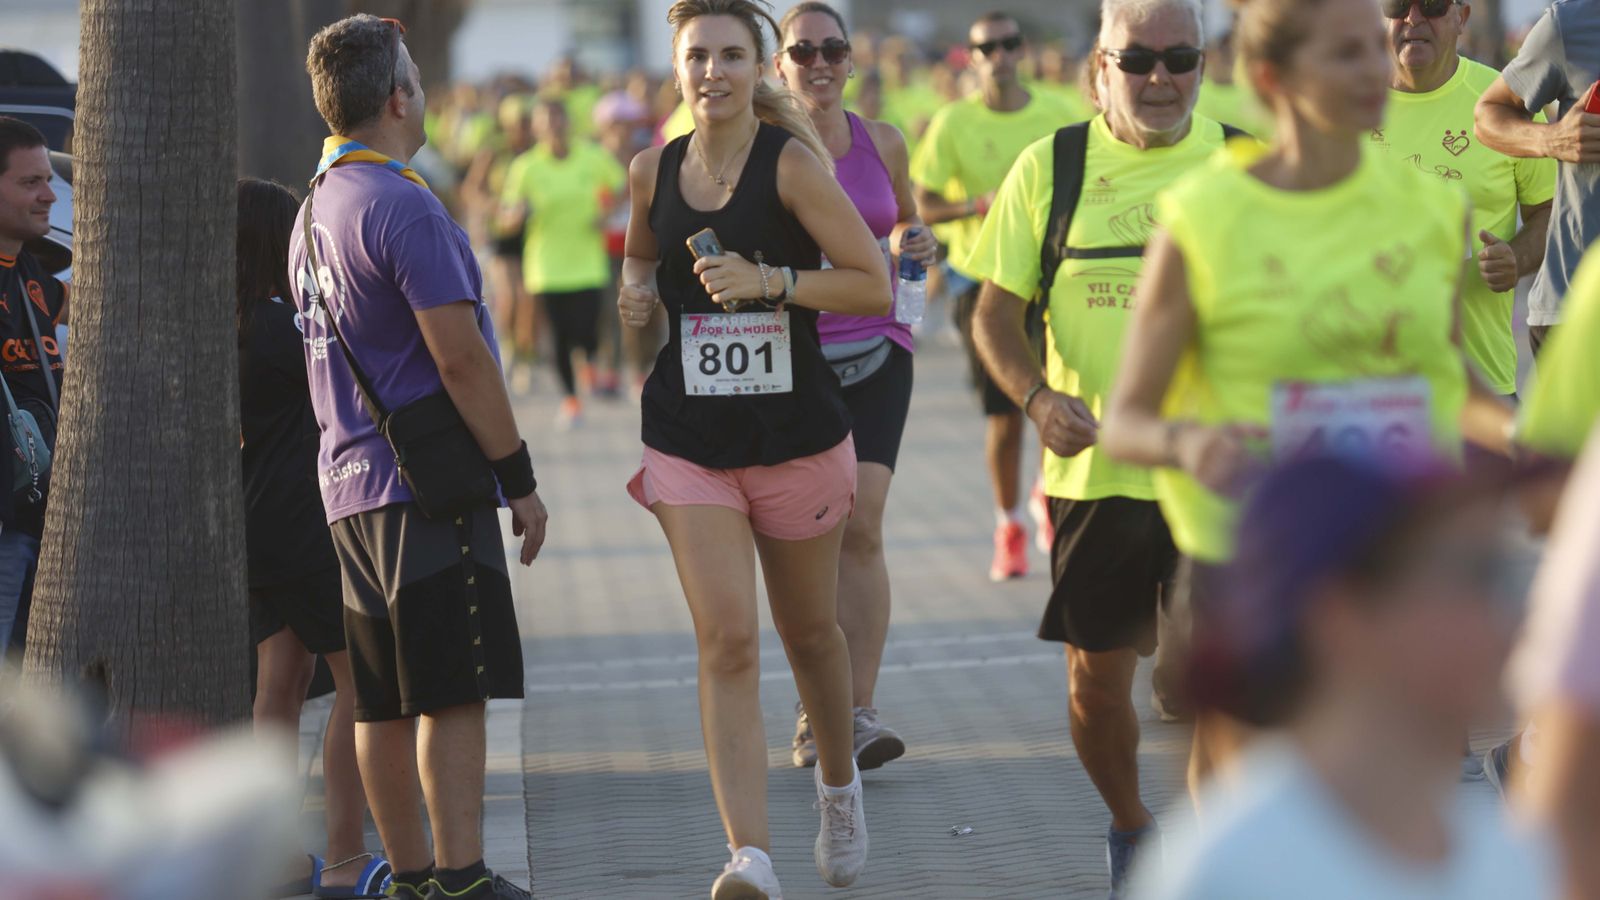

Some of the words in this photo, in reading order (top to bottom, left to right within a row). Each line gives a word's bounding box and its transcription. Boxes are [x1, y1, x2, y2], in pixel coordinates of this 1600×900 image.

[1087, 282, 1111, 294] VII
[1087, 296, 1117, 309] POR
[700, 326, 723, 335] POR
[726, 325, 741, 334] LA
[743, 324, 783, 335] MUJER
[699, 341, 773, 376] 801
